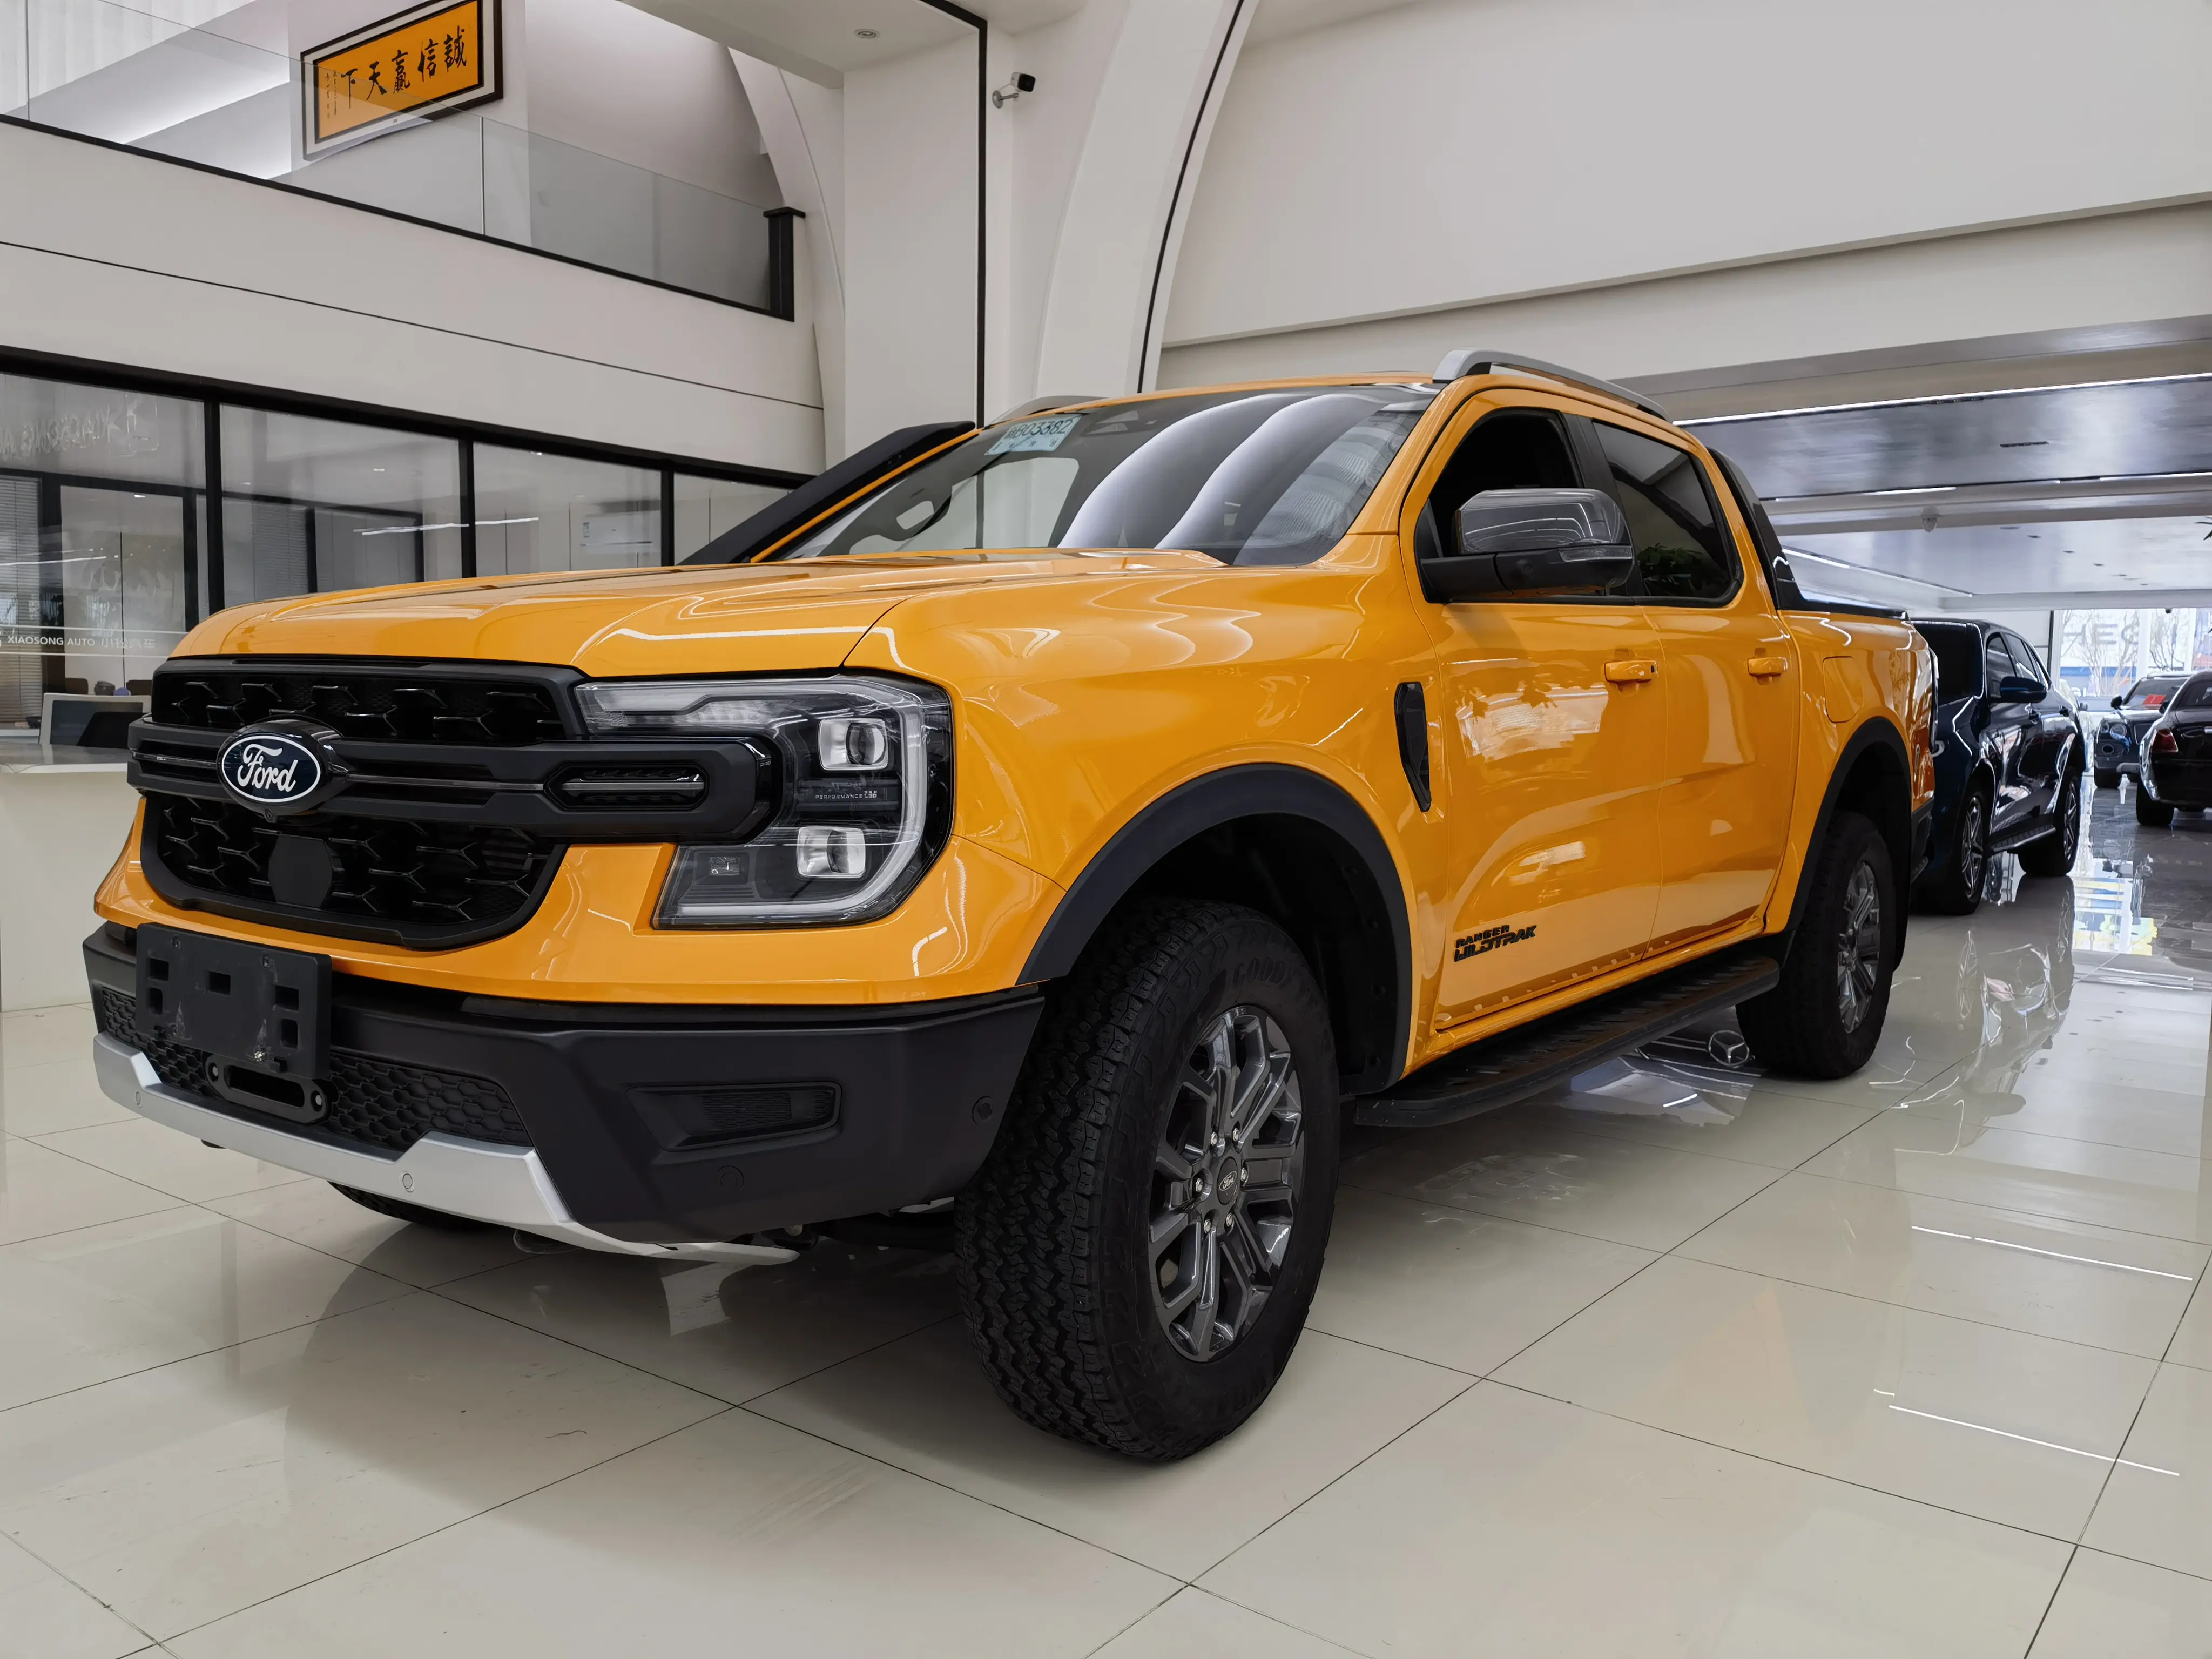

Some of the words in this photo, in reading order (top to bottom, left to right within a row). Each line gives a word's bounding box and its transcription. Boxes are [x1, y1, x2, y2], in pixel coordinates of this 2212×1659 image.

[7, 635, 64, 645] XIAOSONG
[66, 638, 96, 646] AUTO
[237, 744, 299, 792] Ford
[864, 790, 878, 799] LED
[1454, 925, 1537, 962] WILDTRAK
[1456, 925, 1510, 948] RANGER
[1223, 1174, 1235, 1189] Ford
